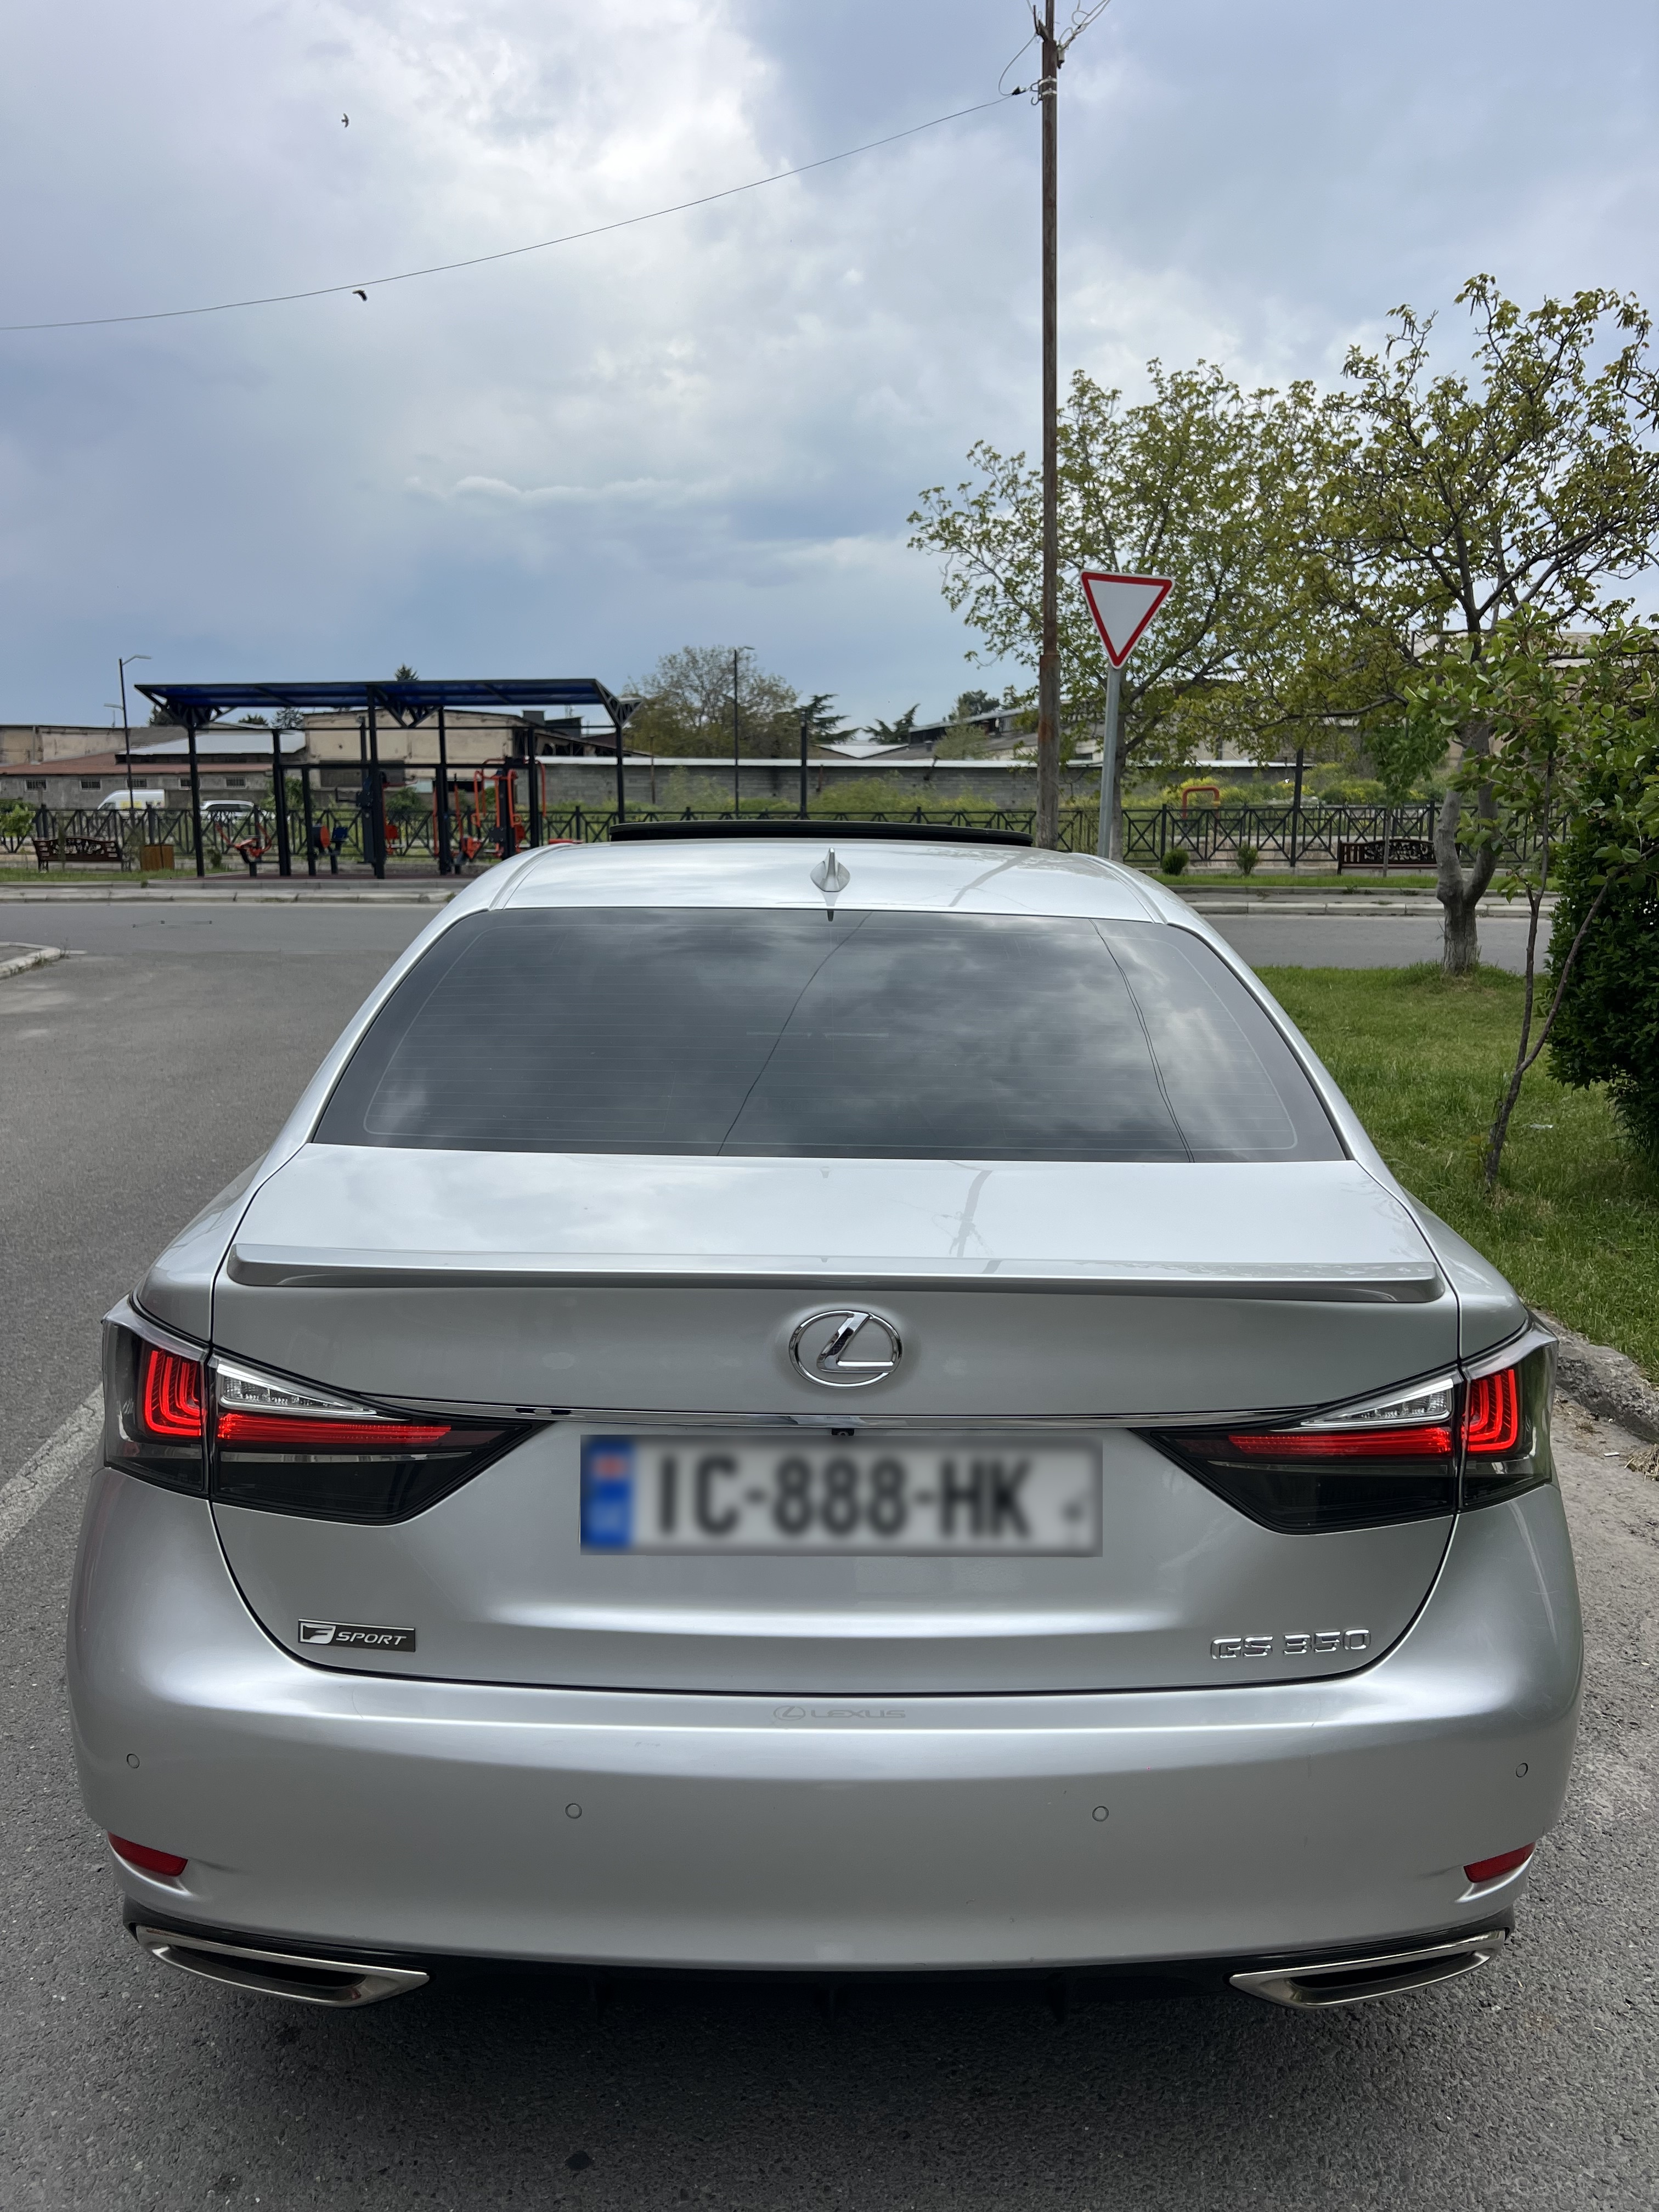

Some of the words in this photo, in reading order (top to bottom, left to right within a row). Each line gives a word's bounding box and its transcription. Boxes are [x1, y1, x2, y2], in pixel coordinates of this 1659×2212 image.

[336, 1632, 407, 1645] SPORT
[1210, 1635, 1273, 1659] GS
[1283, 1628, 1372, 1655] 350
[811, 1709, 906, 1718] LEXUS
